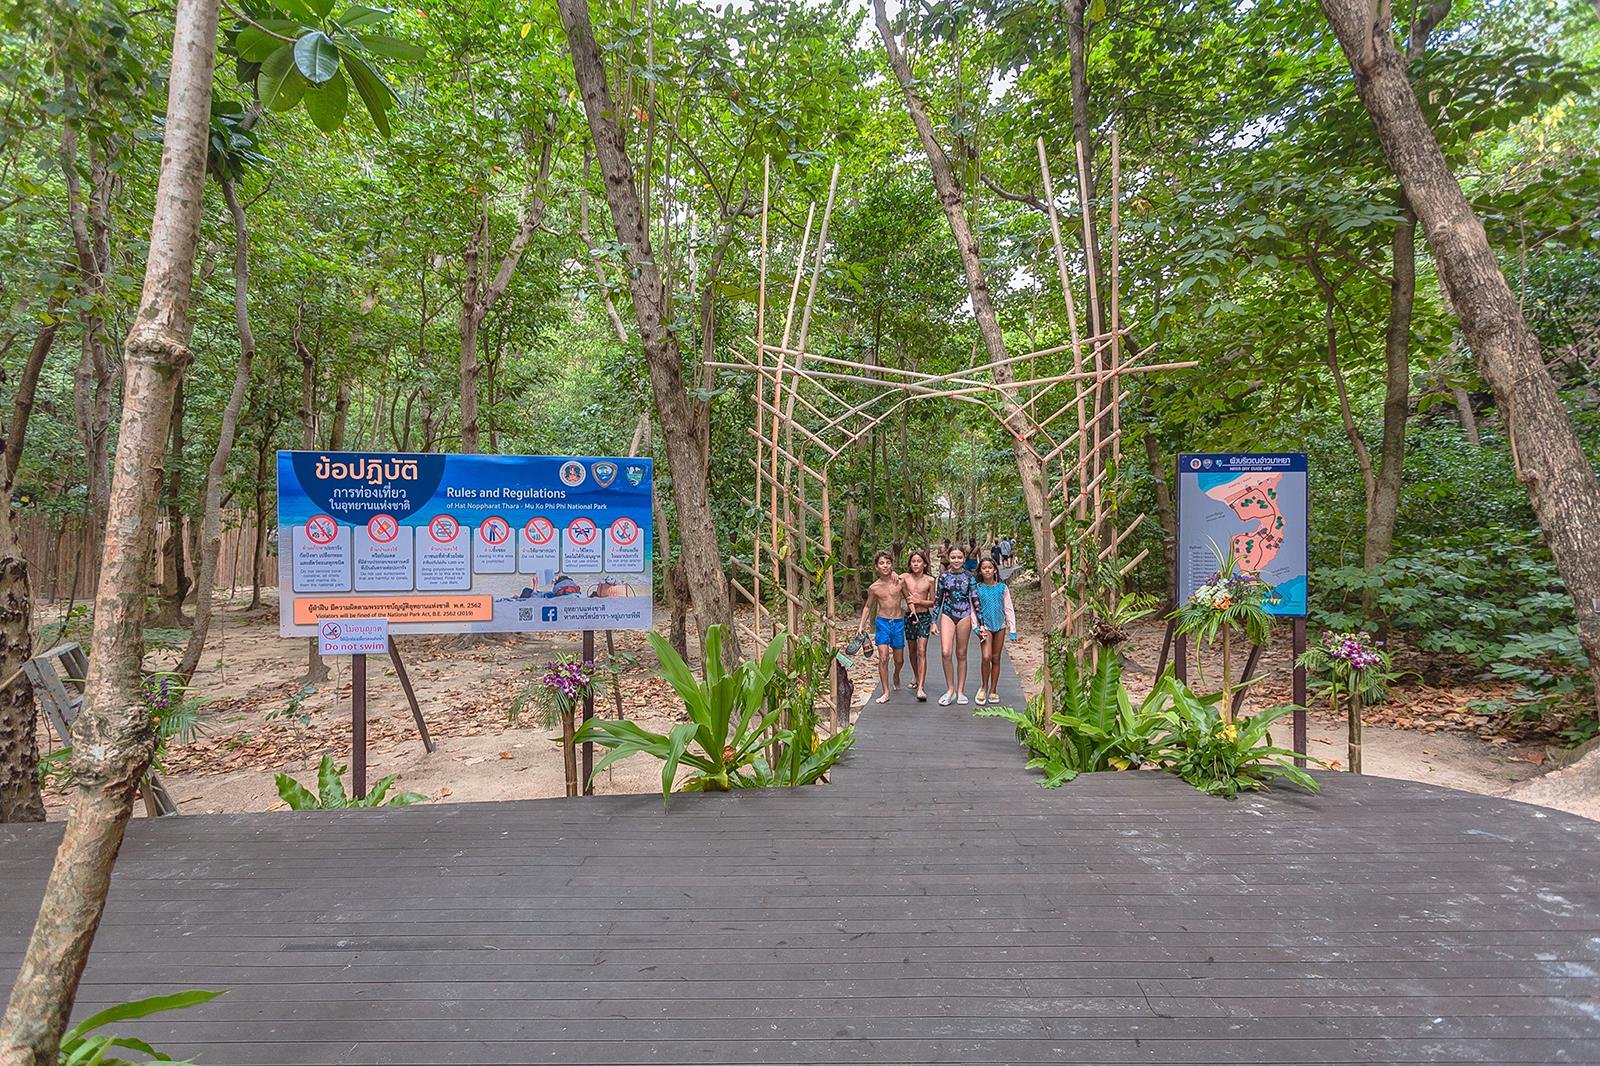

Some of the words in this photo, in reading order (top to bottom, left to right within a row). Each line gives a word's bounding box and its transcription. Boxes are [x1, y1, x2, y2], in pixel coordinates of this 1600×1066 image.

[316, 456, 418, 485] ข้อปฏิบัติ
[333, 482, 408, 498] การท่องเที่ยว
[447, 487, 477, 498] Rules
[480, 488, 500, 498] and
[503, 488, 566, 501] Regulations
[329, 498, 411, 513] ในอุทยานแห่งชาติ
[467, 503, 501, 511] Noppharat
[564, 604, 606, 614] อุทยานแห่งชาติ
[345, 624, 382, 634] ไม่อนุญาต
[325, 643, 339, 651] Do
[341, 643, 357, 651] not
